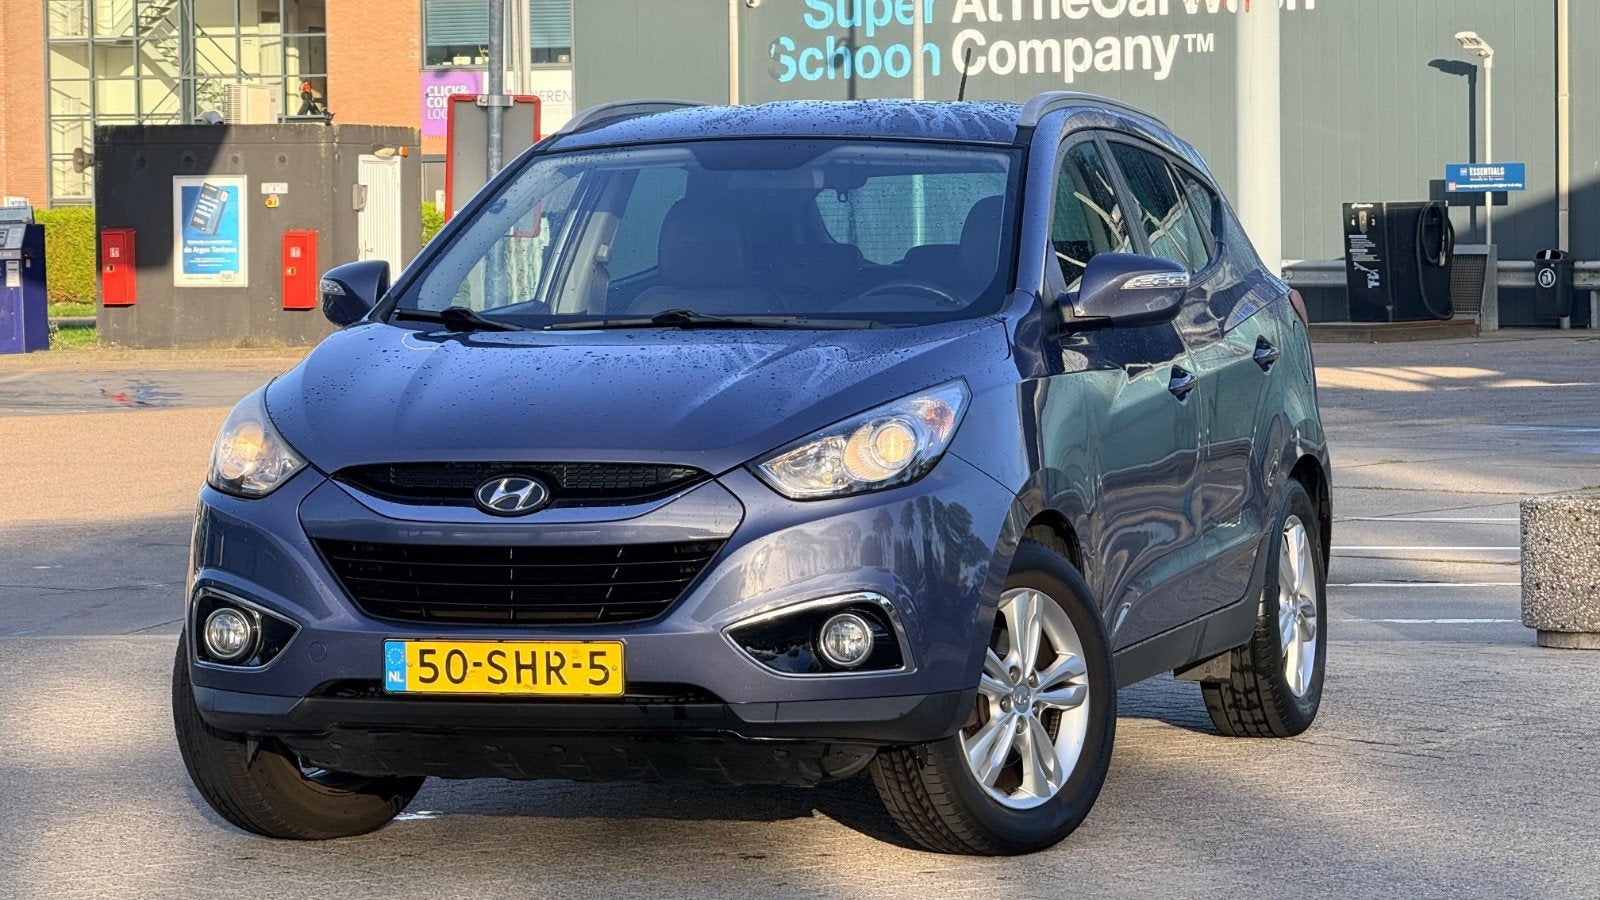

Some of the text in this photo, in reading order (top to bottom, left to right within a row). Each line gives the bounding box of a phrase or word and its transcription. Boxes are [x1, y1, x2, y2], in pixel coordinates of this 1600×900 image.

[768, 36, 940, 83] Schoon
[427, 97, 448, 108] COL
[1469, 167, 1504, 176] ESSENTIALS
[388, 648, 610, 686] NL 50-SHR-5
